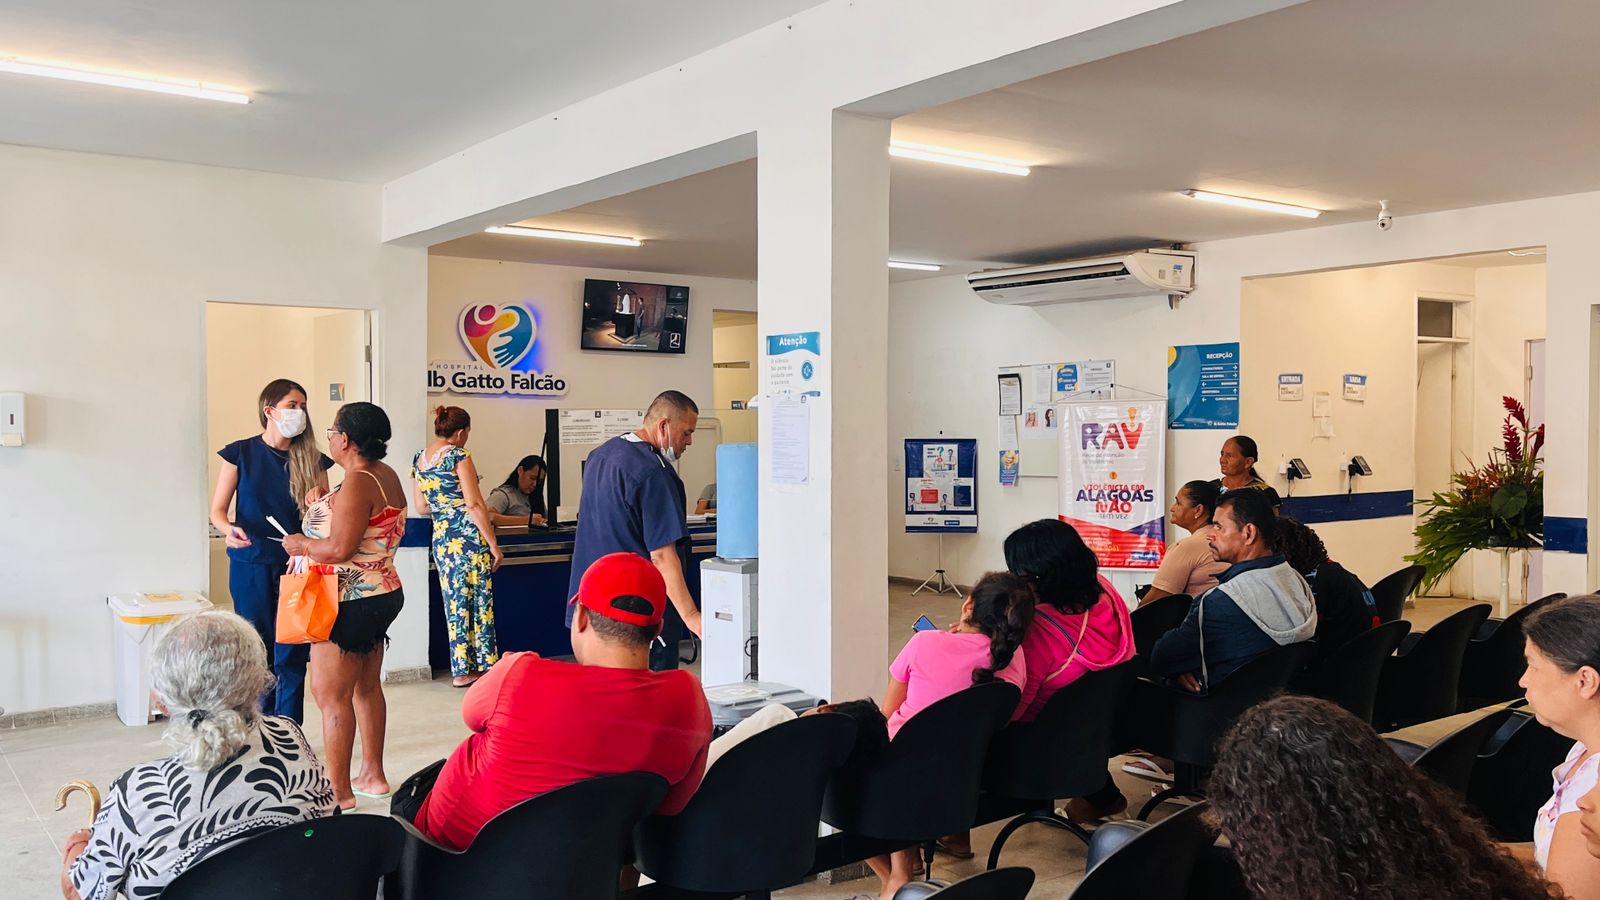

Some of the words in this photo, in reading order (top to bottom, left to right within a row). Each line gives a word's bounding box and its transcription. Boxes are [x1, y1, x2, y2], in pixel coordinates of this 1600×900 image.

[778, 335, 808, 347] Atenção
[451, 372, 505, 389] Gatto
[511, 373, 566, 391] Falcão
[1081, 422, 1144, 450] RAV
[1083, 483, 1129, 491] VIOLÊNCIA
[1076, 489, 1154, 502] ALAGOAS
[1095, 498, 1133, 513] NÃO
